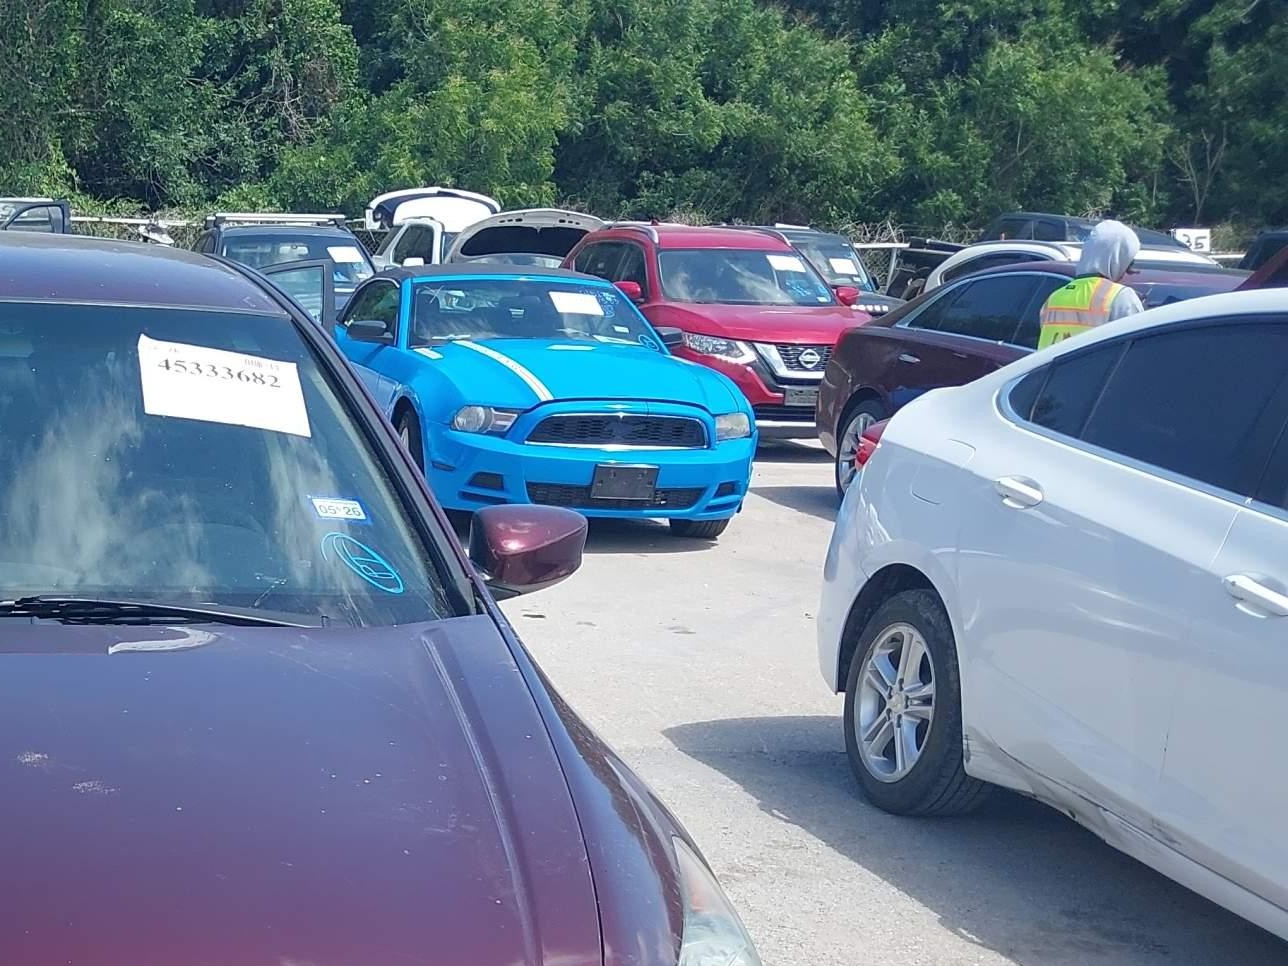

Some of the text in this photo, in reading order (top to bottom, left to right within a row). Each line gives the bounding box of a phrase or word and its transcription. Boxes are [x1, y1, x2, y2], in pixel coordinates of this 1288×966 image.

[157, 358, 281, 388] 45333682
[318, 504, 362, 517] 05 26
